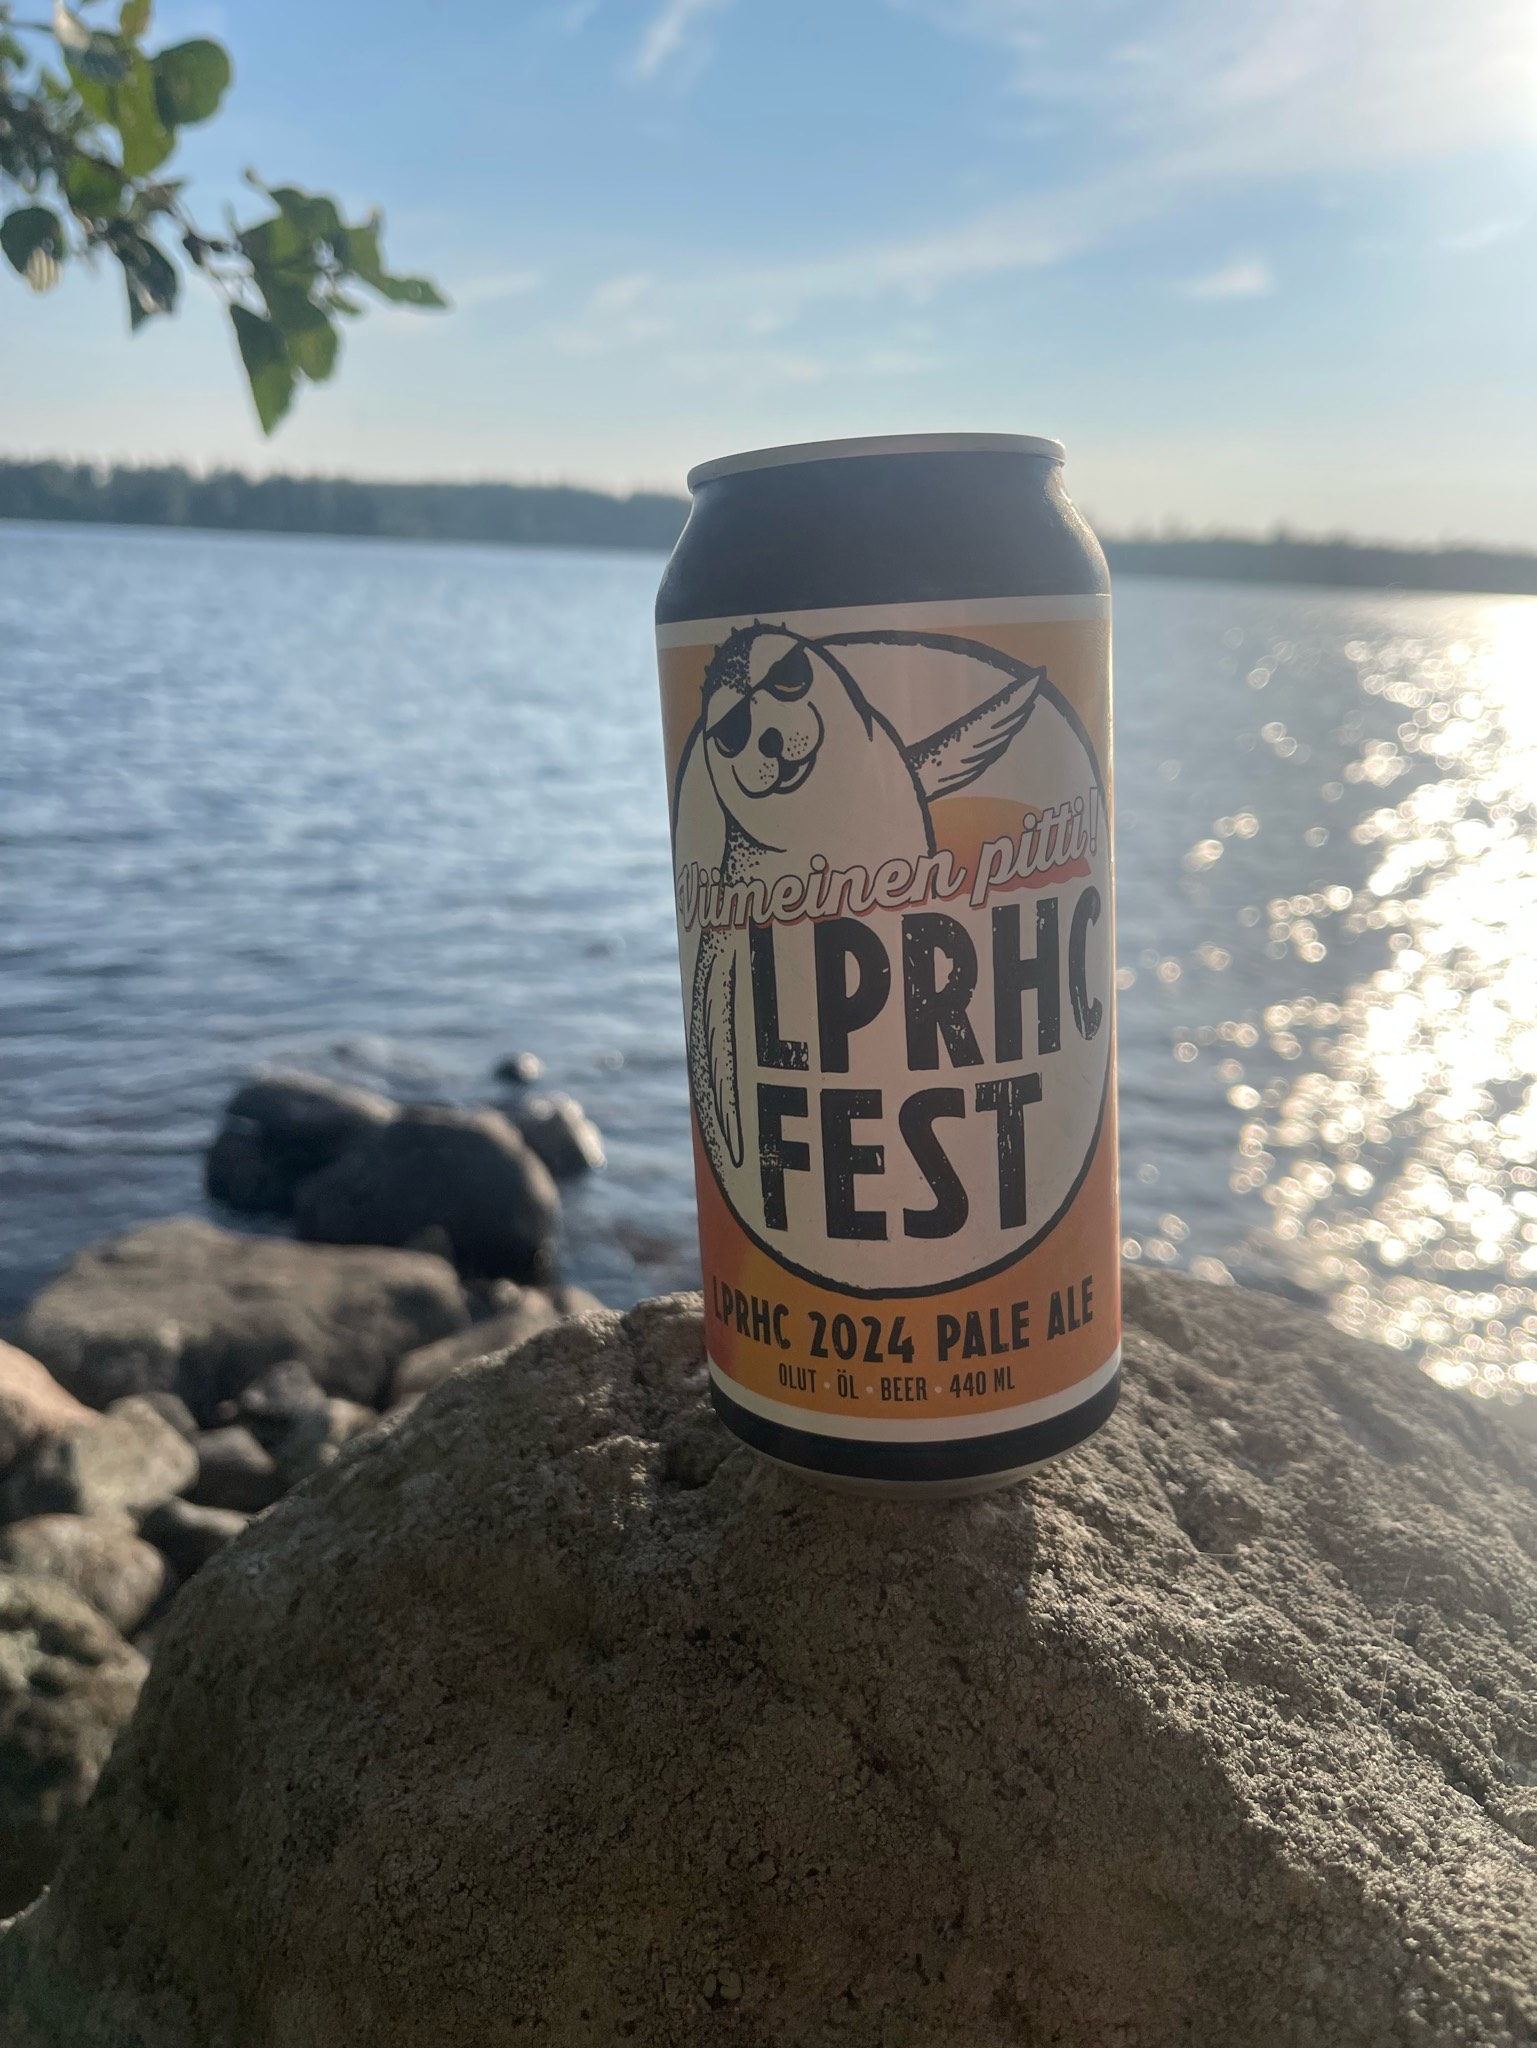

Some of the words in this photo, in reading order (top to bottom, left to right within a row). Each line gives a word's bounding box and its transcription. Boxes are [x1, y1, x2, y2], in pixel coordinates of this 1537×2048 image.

[677, 849, 966, 932] Viimeinen
[970, 786, 1099, 909] pitti!
[748, 885, 1104, 1073] LPRHC
[756, 1072, 1043, 1241] FEST
[713, 1275, 791, 1350] LPRHC
[808, 1311, 915, 1363] 2024
[936, 1300, 1030, 1362] PALE
[1046, 1274, 1094, 1341] ALE
[778, 1362, 817, 1393] OLUT
[837, 1369, 860, 1400] ÖL
[880, 1376, 928, 1401] BEER
[949, 1370, 987, 1399] 440
[994, 1365, 1016, 1392] ML
